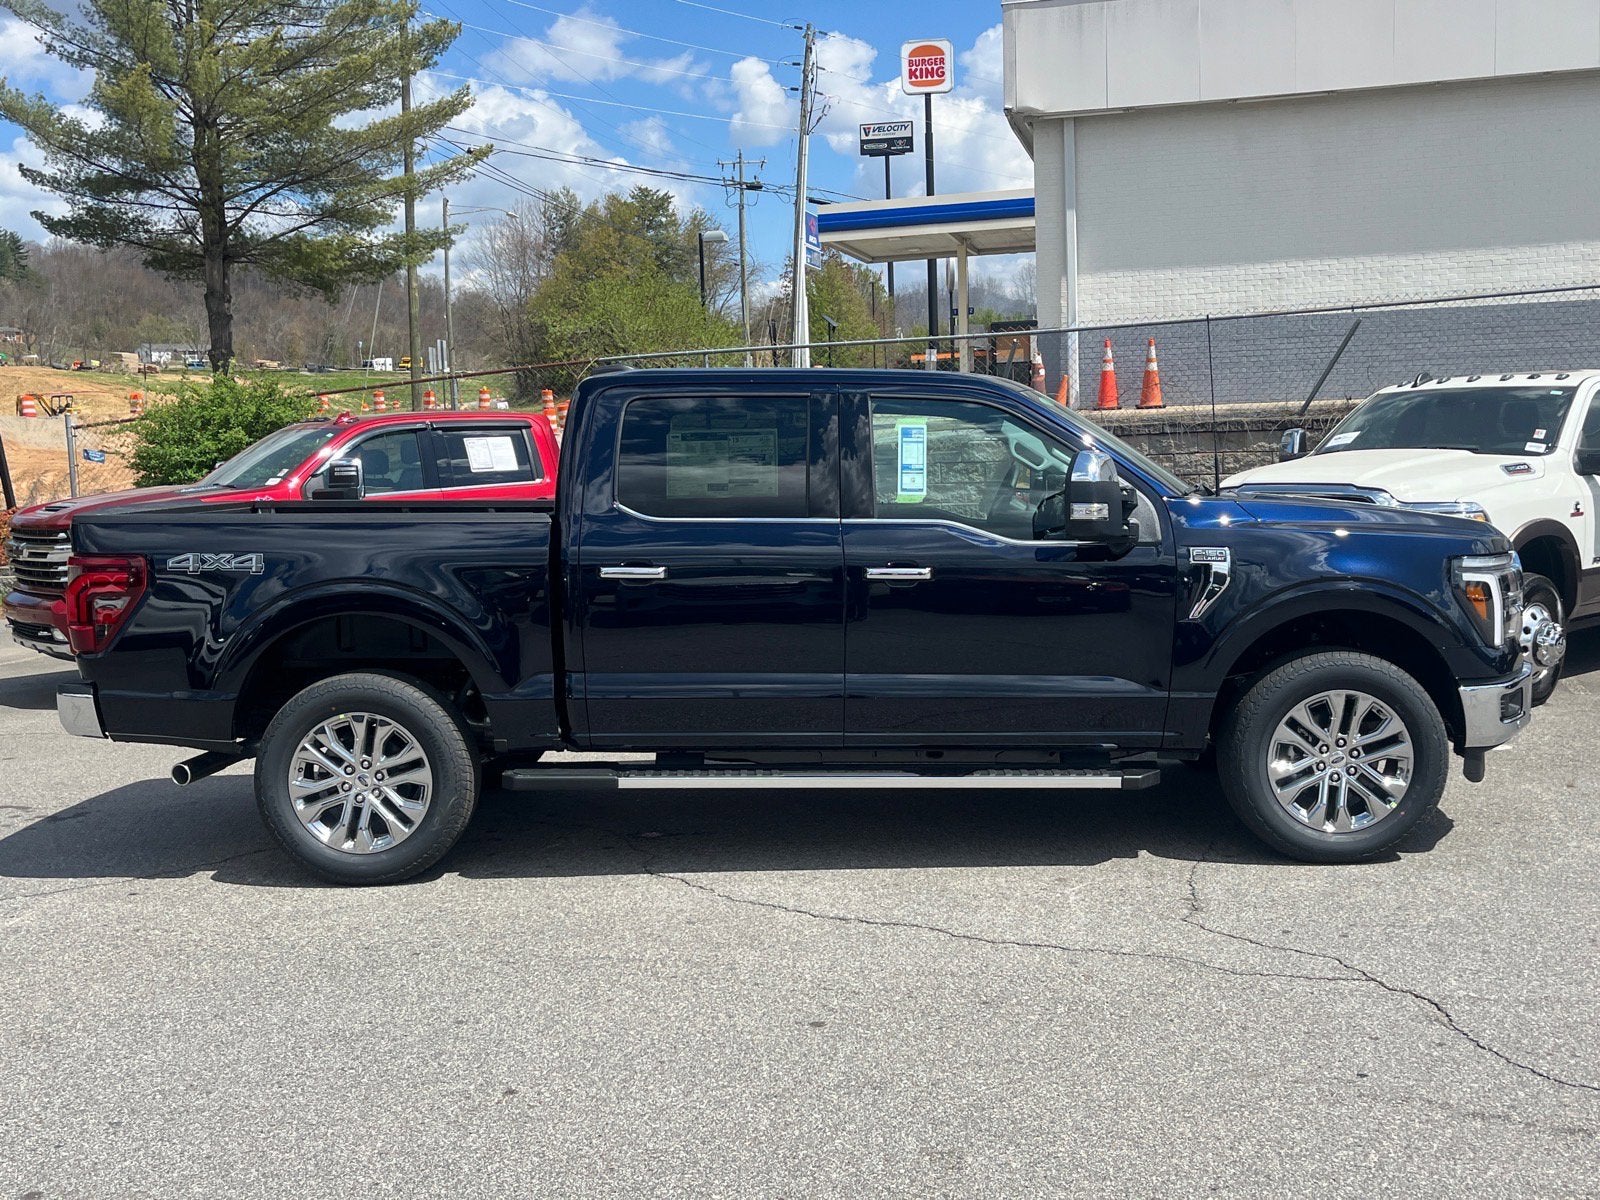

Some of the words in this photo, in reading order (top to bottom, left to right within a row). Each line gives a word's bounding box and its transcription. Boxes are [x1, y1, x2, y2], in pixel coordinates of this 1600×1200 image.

[908, 57, 945, 67] BURGER
[908, 66, 945, 80] KING
[872, 124, 909, 133] VELOCITY
[1193, 549, 1226, 557] F-150
